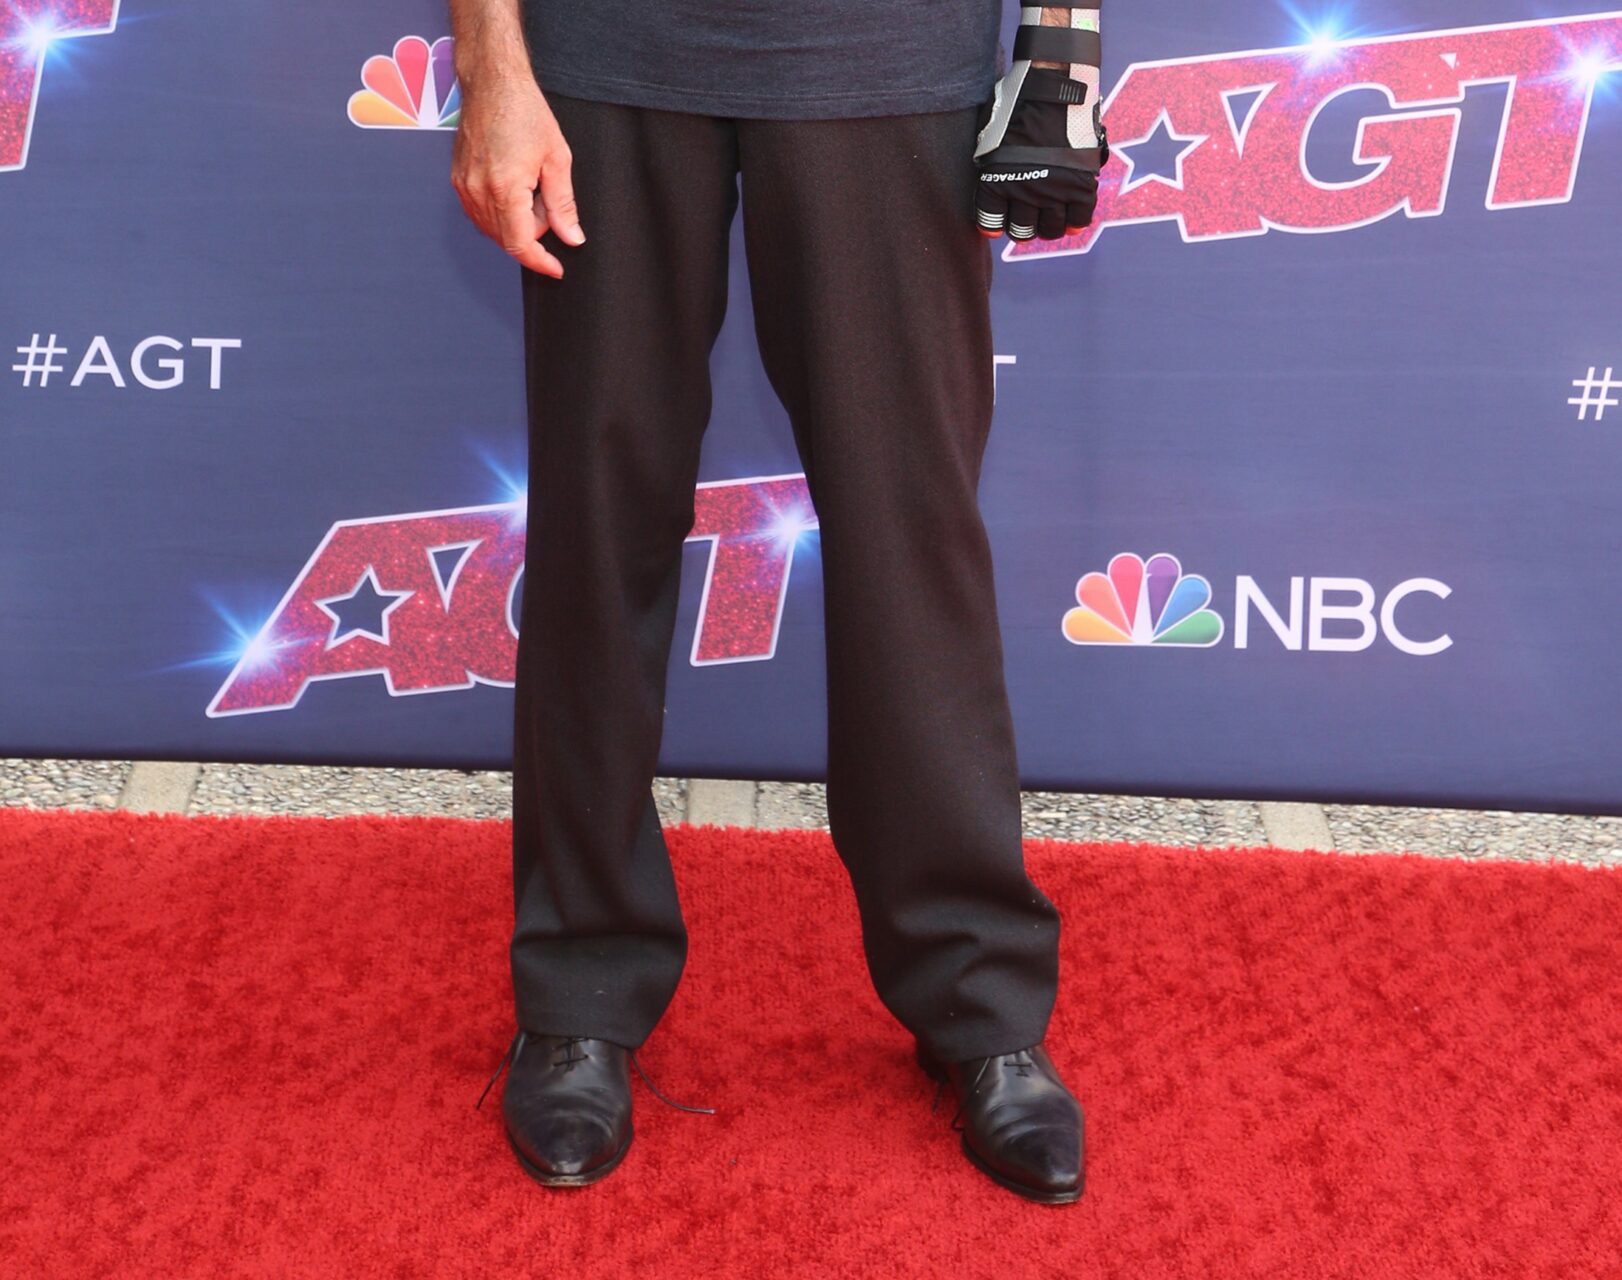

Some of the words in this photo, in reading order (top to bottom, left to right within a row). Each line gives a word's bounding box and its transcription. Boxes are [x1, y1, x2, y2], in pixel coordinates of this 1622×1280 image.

[1002, 12, 1622, 261] AGT
[980, 168, 1049, 183] BONTRAGER
[12, 334, 242, 390] #AGT
[1234, 575, 1454, 656] NBC
